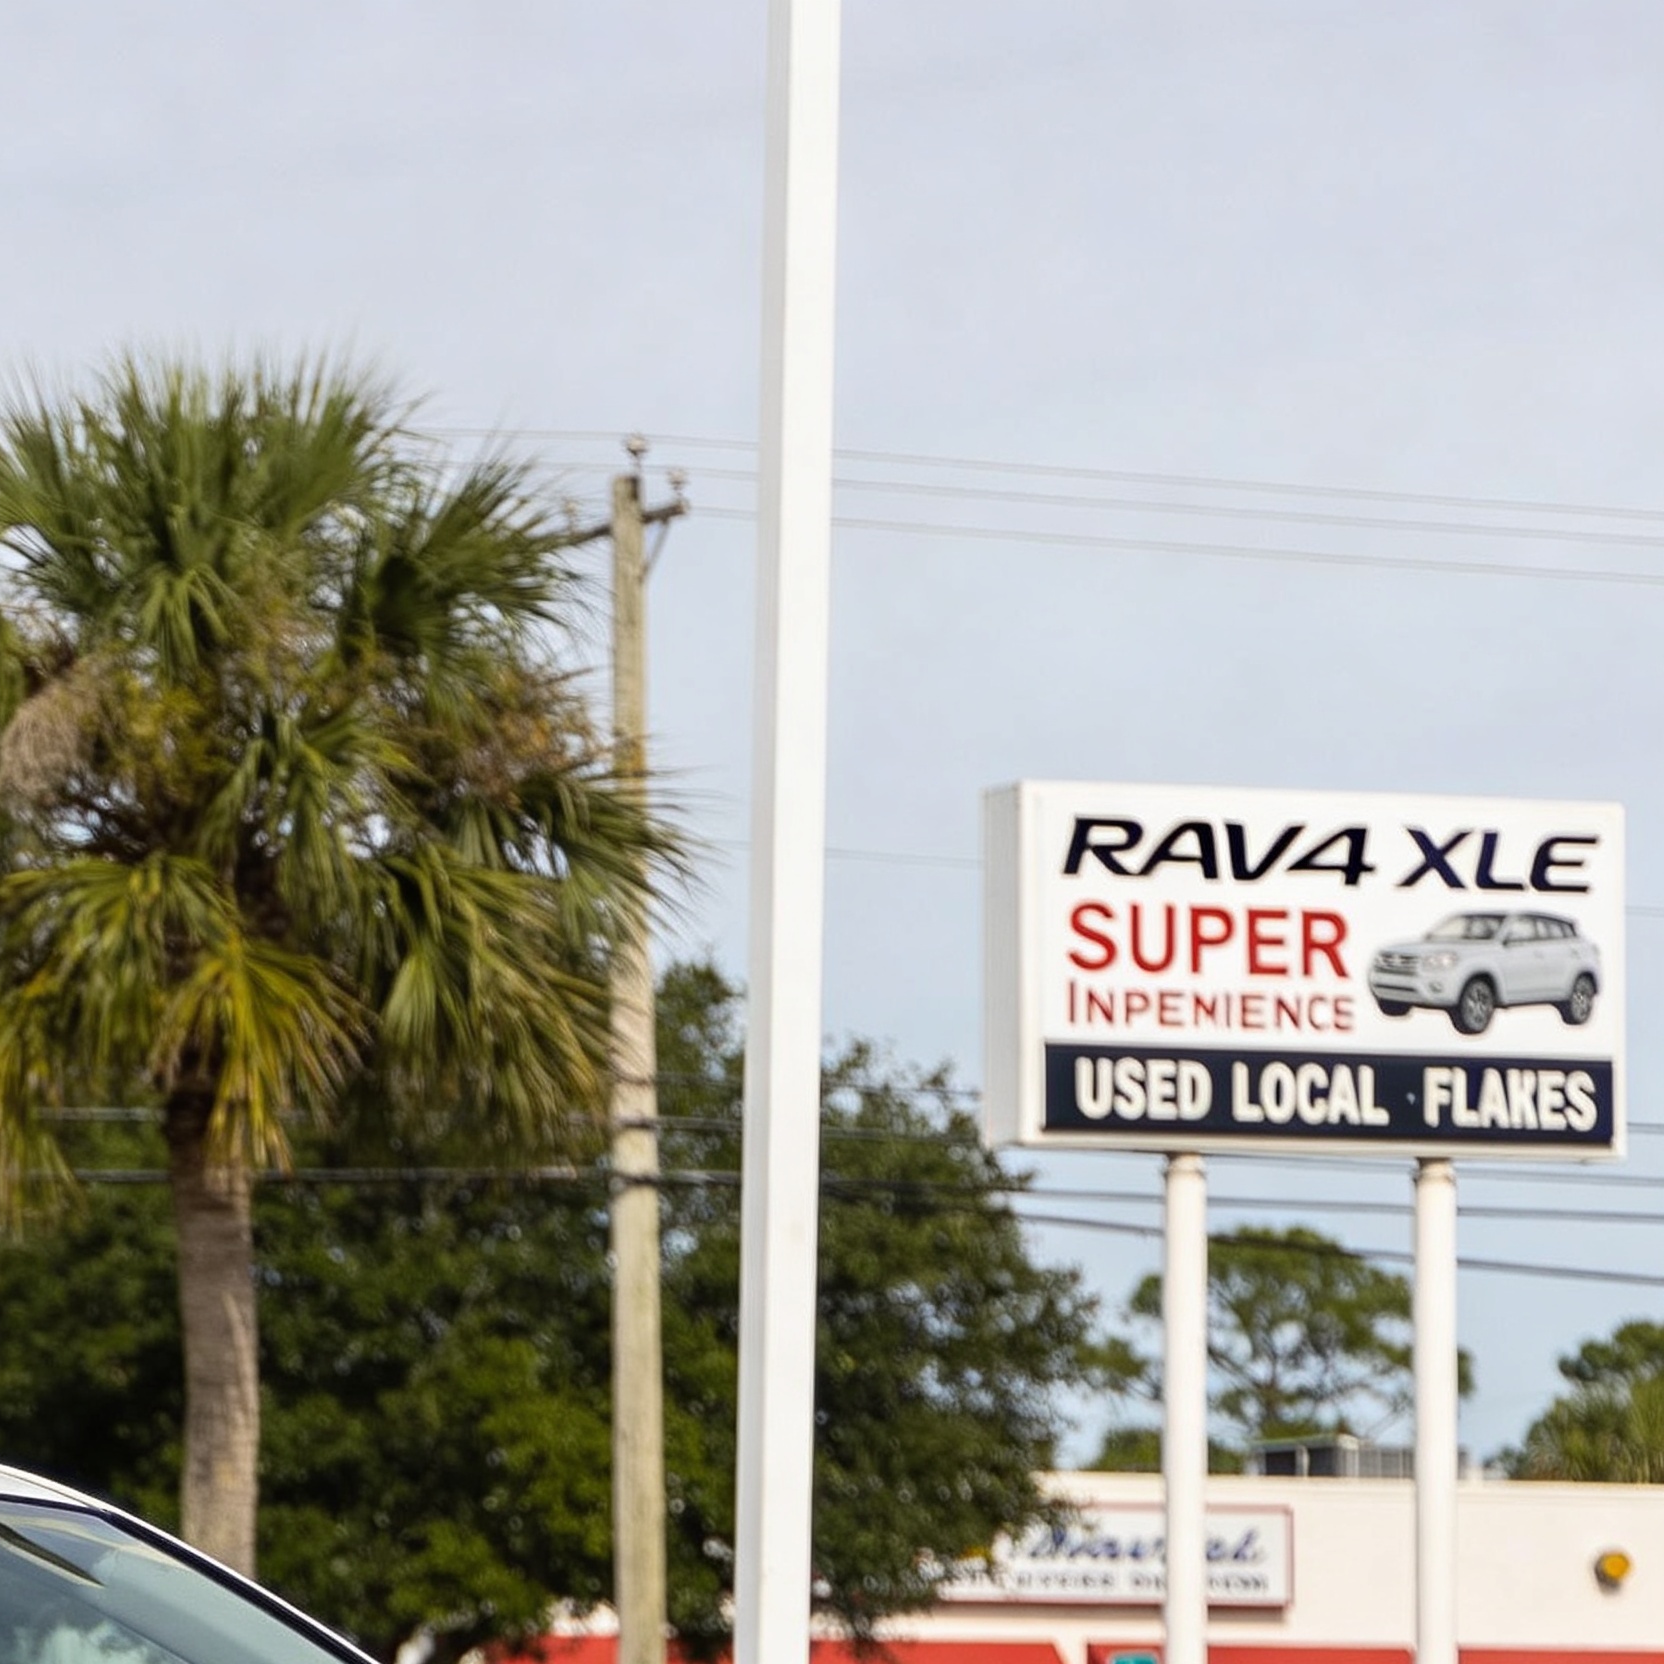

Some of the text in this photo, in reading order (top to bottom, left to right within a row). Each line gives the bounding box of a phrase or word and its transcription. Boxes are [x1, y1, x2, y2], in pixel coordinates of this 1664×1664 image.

[1063, 815, 1601, 894] RAV4 XLE
[1068, 901, 1350, 977] SUPER
[1075, 1056, 1598, 1132] USED LOCAL FLAKES
